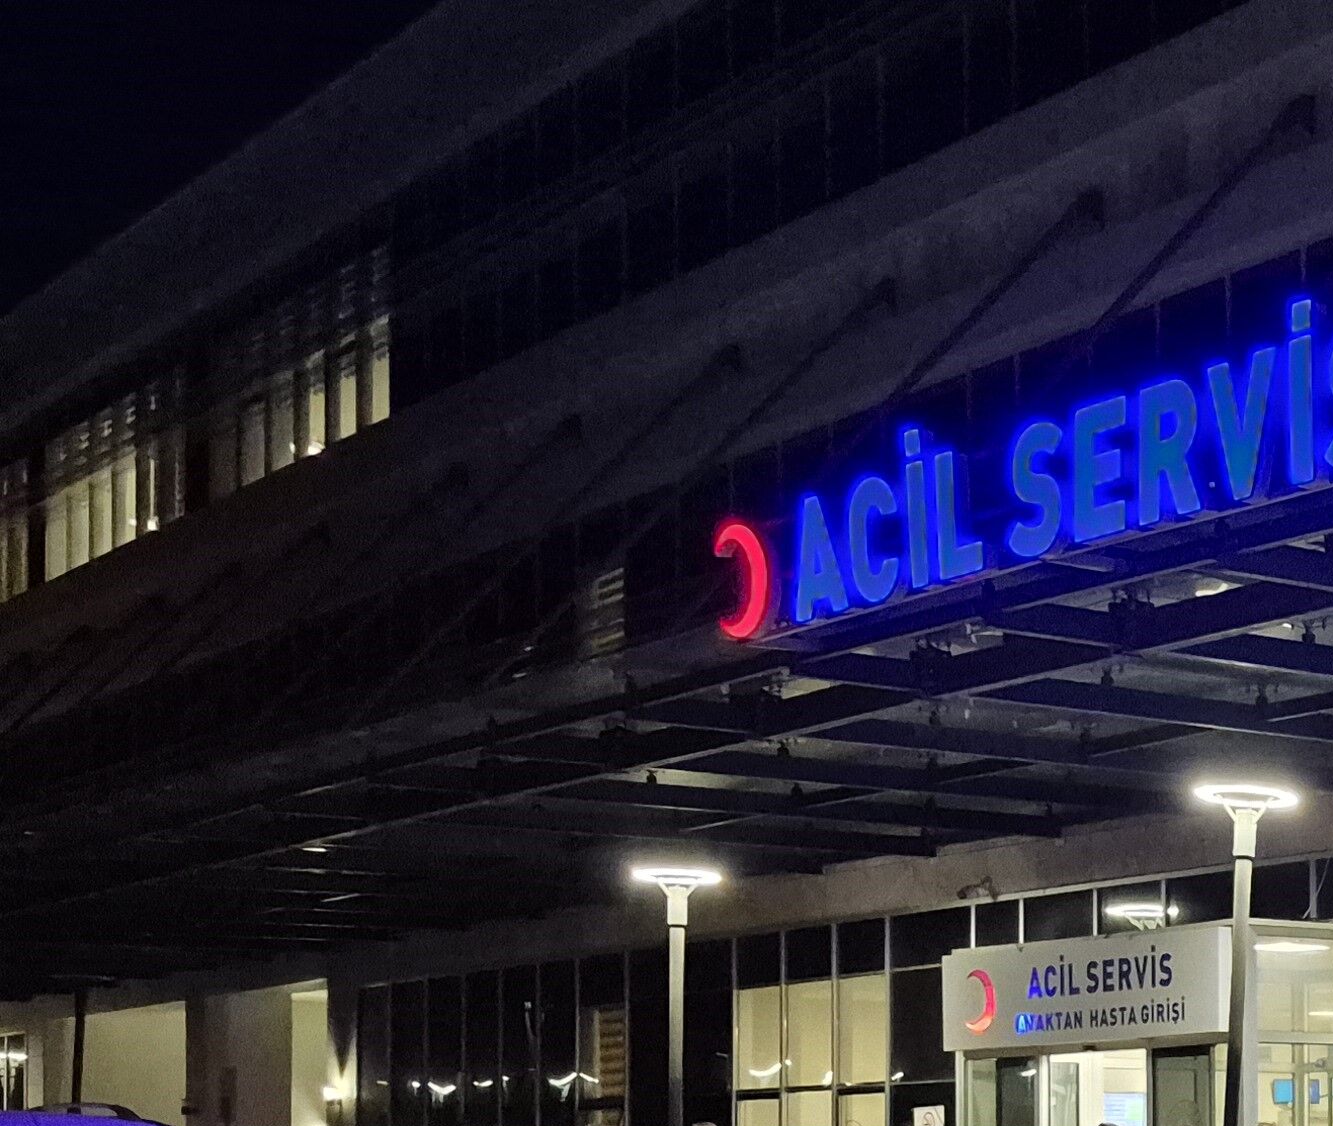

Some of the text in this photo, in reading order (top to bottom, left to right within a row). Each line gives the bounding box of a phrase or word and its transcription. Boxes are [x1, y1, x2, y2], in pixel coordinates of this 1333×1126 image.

[790, 428, 982, 620] ACİL
[1027, 945, 1173, 999] ACİL SERVİS
[1090, 1006, 1137, 1028] HASTA
[1141, 995, 1185, 1025] GİRİŞİ
